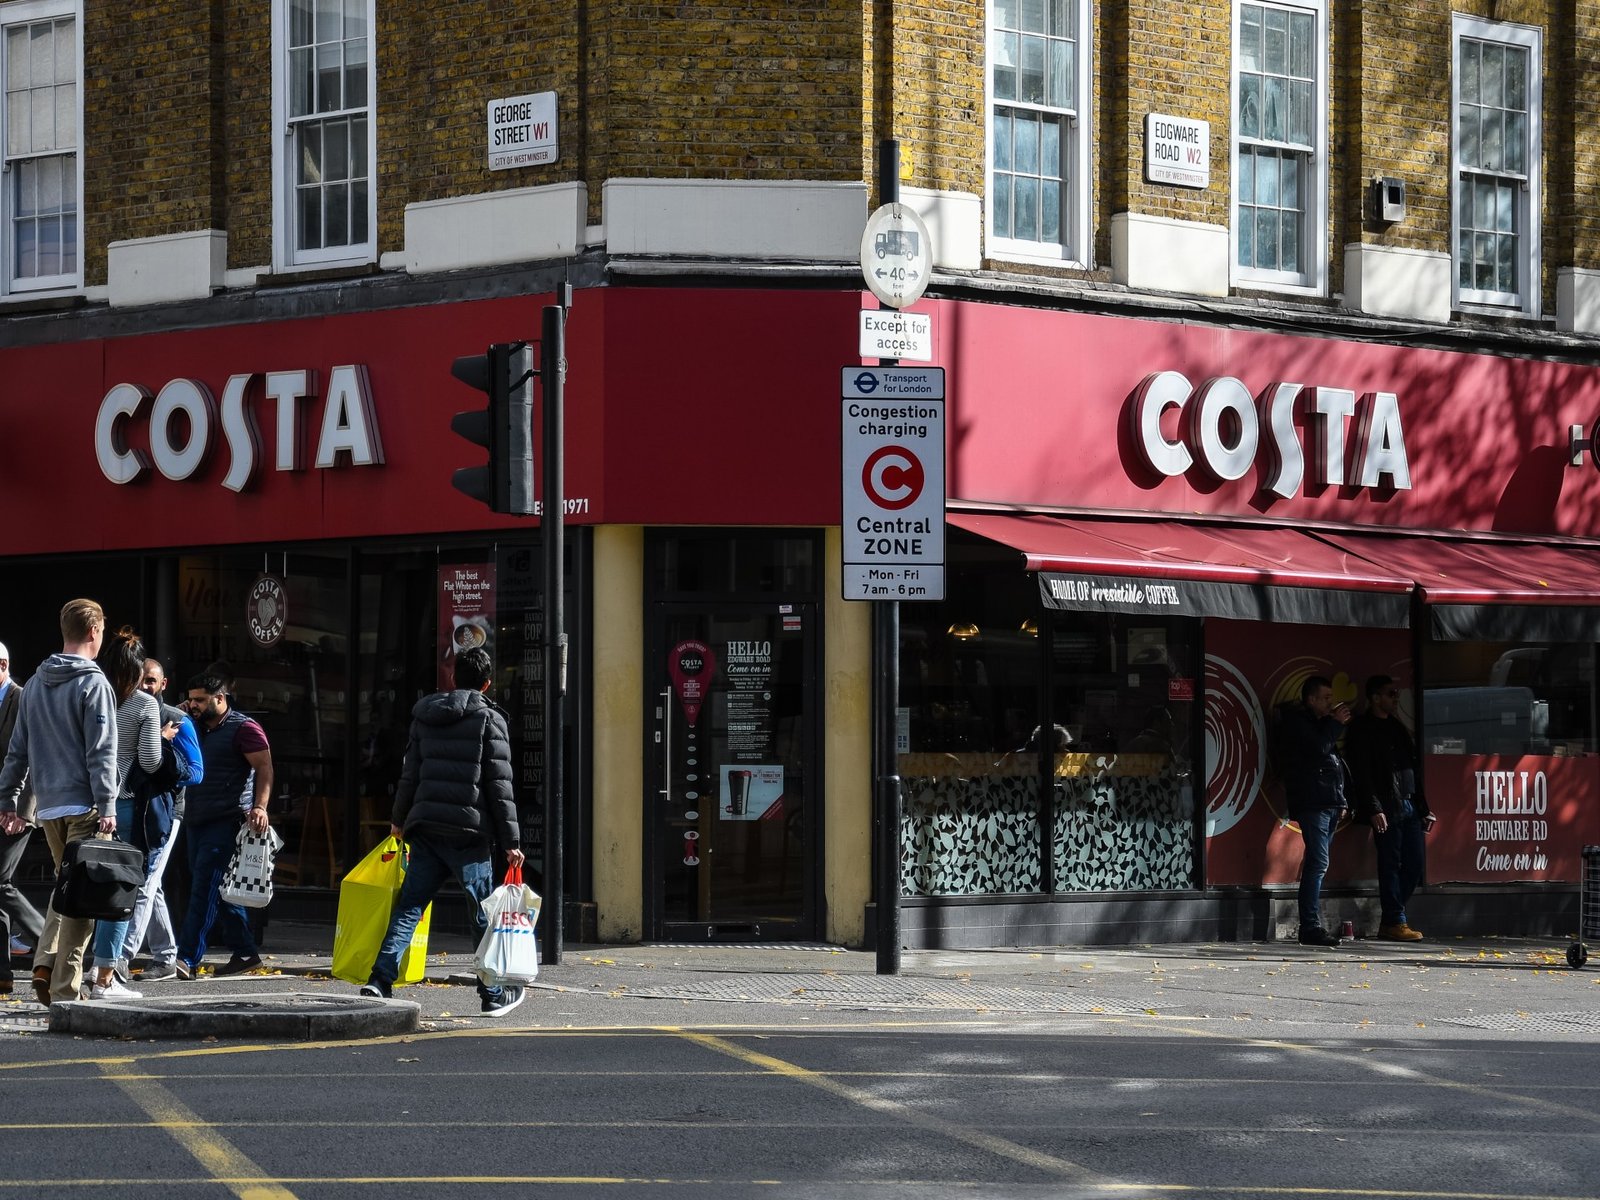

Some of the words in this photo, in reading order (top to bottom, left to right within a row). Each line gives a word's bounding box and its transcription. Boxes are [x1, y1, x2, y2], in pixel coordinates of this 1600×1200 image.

[494, 102, 532, 124] GEORGE
[494, 125, 531, 146] STREET
[533, 121, 549, 141] W1
[1155, 121, 1200, 144] EDGWARE
[495, 156, 506, 167] CITY
[506, 156, 513, 165] OF
[514, 151, 549, 164] WESTMINSTER
[1155, 142, 1180, 162] ROAD
[1186, 146, 1202, 165] W2
[1155, 169, 1165, 178] CITY
[1165, 171, 1171, 179] OF
[1172, 172, 1204, 184] WESTMINSTER
[889, 267, 906, 281] 40
[864, 317, 908, 335] Except
[911, 321, 928, 334] for
[876, 338, 918, 351] access
[882, 373, 928, 384] Transport
[883, 384, 897, 393] for
[898, 384, 932, 393] London
[848, 403, 938, 421] Congestion
[95, 365, 379, 492] COSTA
[858, 421, 928, 438] charging
[1138, 371, 1412, 500] COSTA
[562, 498, 589, 515] 1971
[856, 516, 932, 534] Central
[863, 538, 924, 555] ZONE
[455, 570, 466, 580] The
[467, 570, 478, 580] best
[869, 569, 895, 580] Mon
[904, 569, 920, 580] Fri
[253, 580, 280, 600] COSTA
[444, 581, 455, 591] Flat
[455, 581, 472, 591] White
[481, 581, 490, 590] the
[1050, 579, 1077, 601] HOME
[1077, 581, 1090, 601] OF
[1091, 581, 1145, 604] irresistible
[1145, 585, 1180, 605] COFFEE
[452, 591, 465, 604] high
[465, 591, 482, 601] street.
[251, 617, 284, 641] COFFEE
[524, 623, 543, 641] COF
[727, 641, 771, 656] HELLO
[680, 659, 703, 668] COSTA
[727, 664, 750, 673] Come
[762, 664, 771, 673] in
[1475, 771, 1548, 815] HELLO
[1476, 820, 1530, 841] EDGWARE
[1532, 820, 1548, 841] RD
[244, 853, 264, 865] M&S
[1476, 846, 1512, 871] Come
[1513, 853, 1532, 871] on
[1533, 846, 1548, 871] in
[498, 911, 532, 927] ESC
